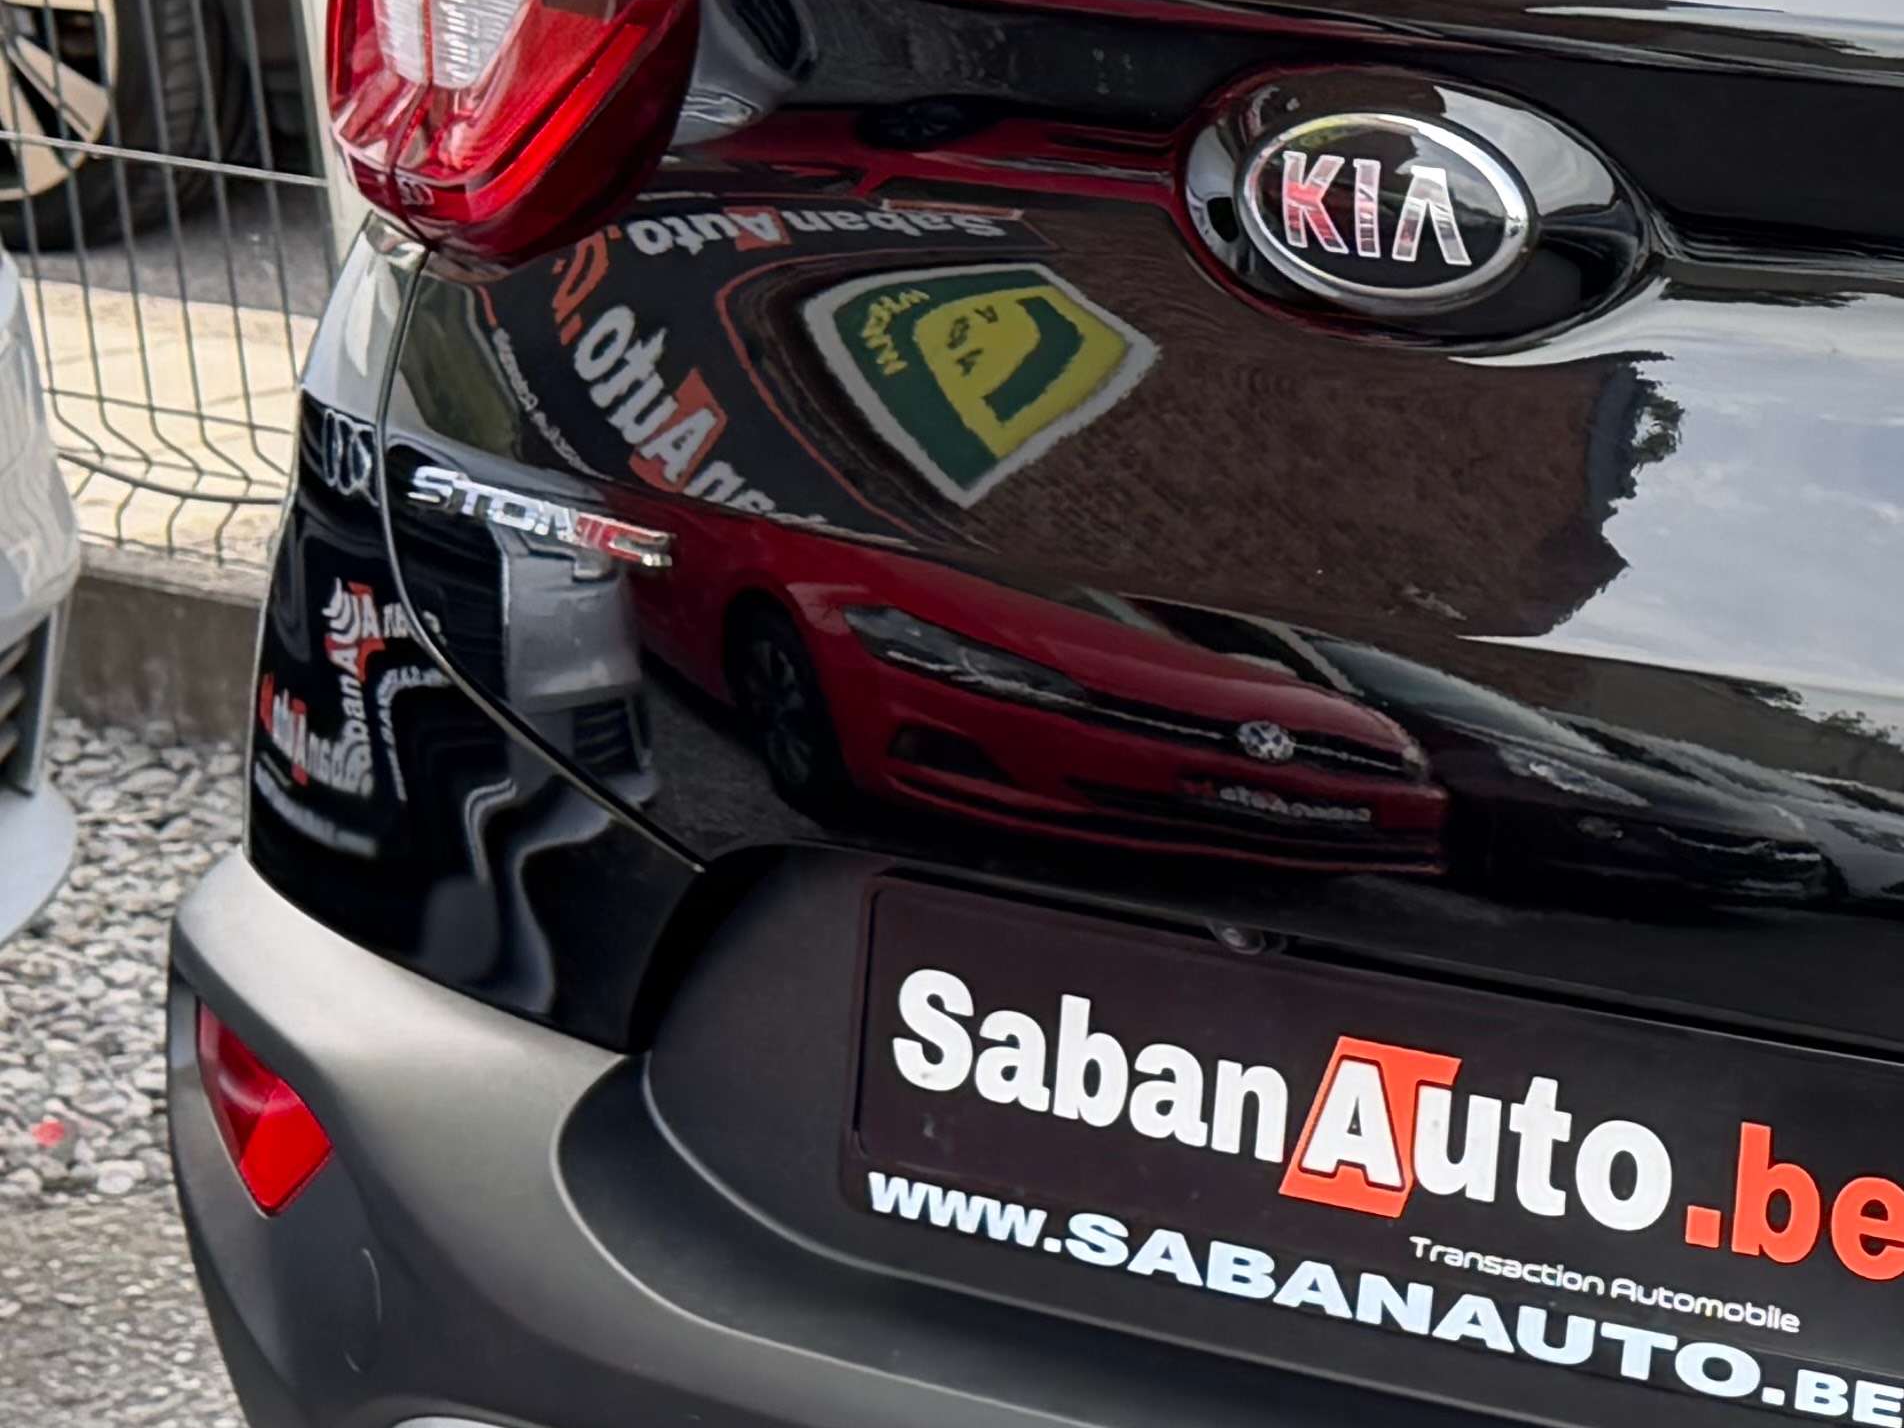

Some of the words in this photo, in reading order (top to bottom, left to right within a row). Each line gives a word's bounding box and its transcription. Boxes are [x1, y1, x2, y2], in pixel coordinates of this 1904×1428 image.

[1281, 149, 1473, 268] KIA
[405, 465, 676, 567] STONIC
[1408, 1236, 1605, 1297] Transaction
[1610, 1277, 1801, 1334] Automobile
